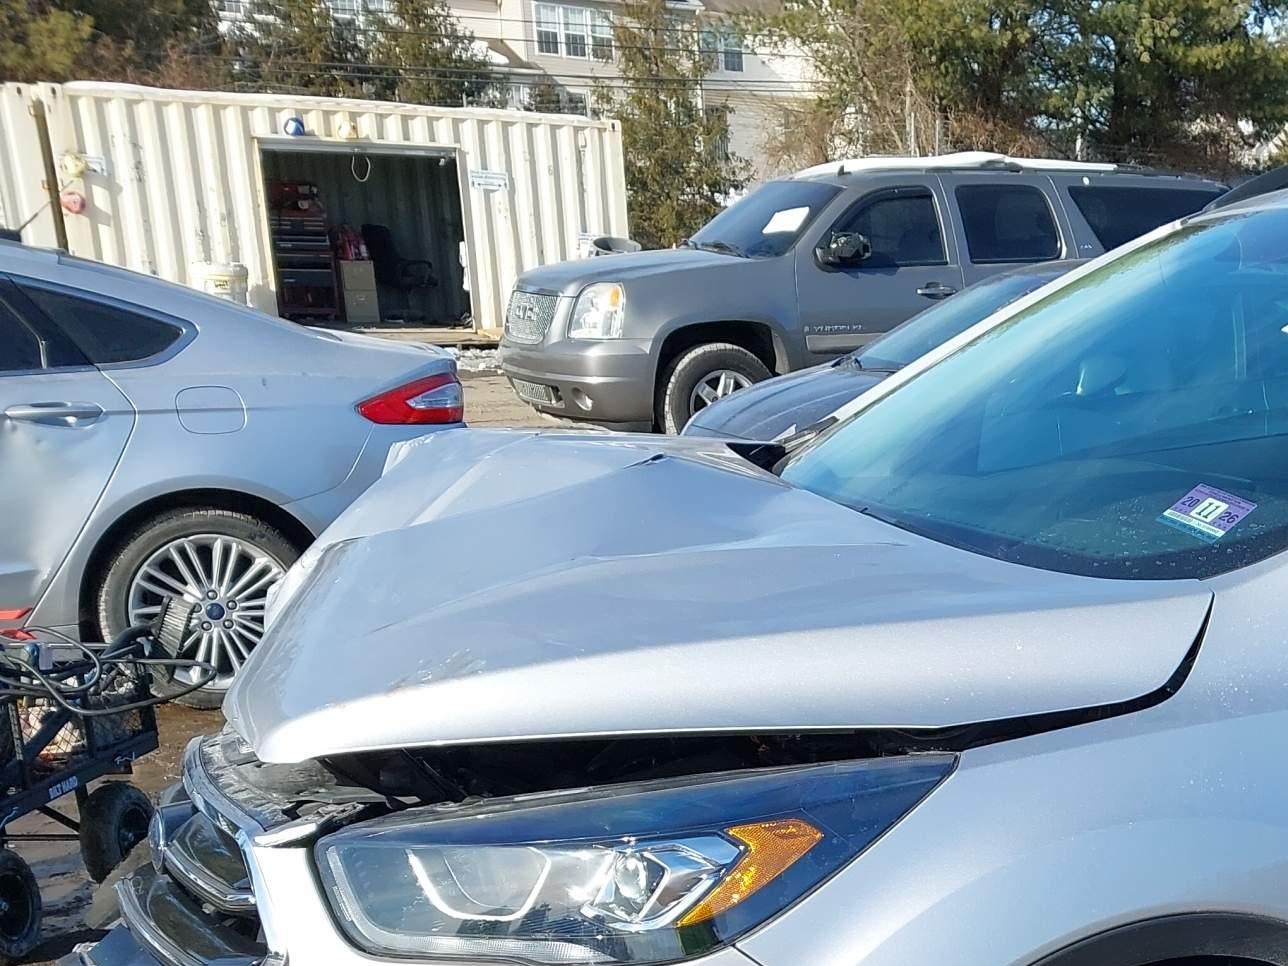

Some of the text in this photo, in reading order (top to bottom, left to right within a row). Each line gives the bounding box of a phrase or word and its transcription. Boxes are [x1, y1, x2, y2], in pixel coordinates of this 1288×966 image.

[1180, 496, 1201, 508] 20
[1195, 502, 1221, 520] 11
[1218, 511, 1240, 525] 26
